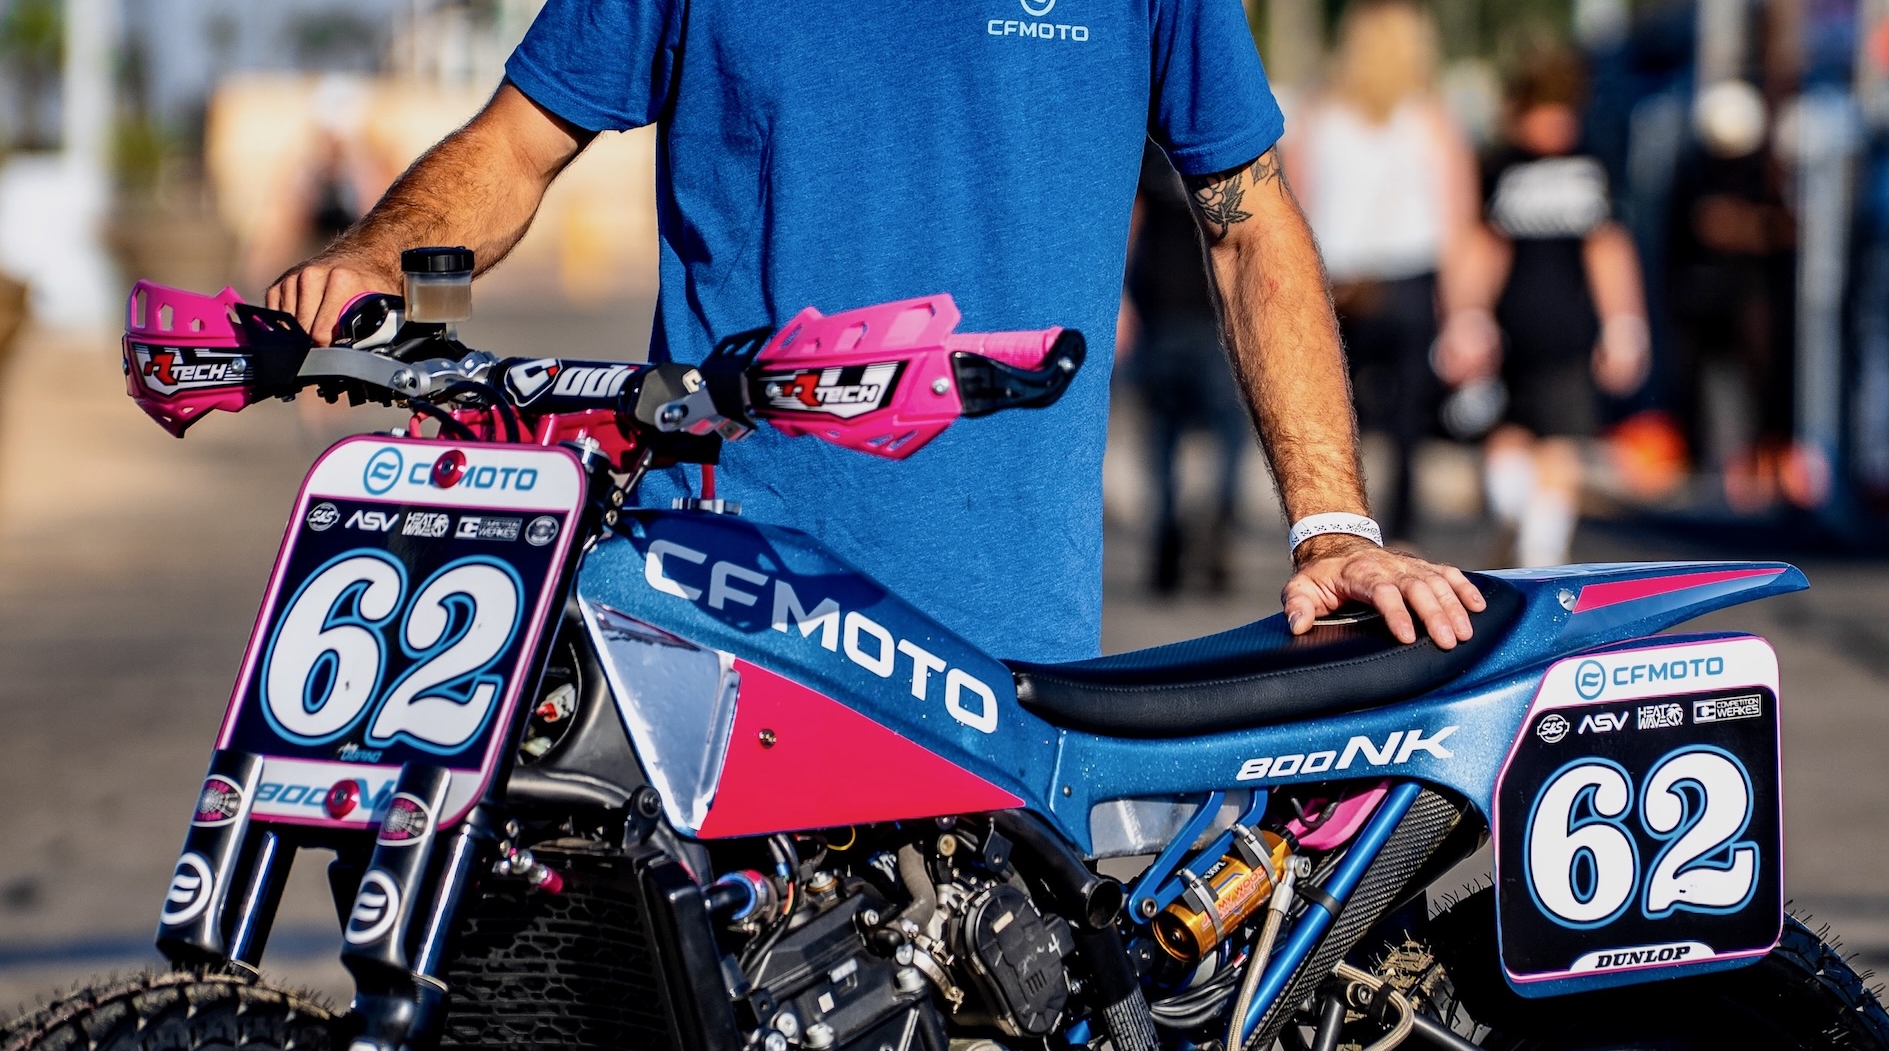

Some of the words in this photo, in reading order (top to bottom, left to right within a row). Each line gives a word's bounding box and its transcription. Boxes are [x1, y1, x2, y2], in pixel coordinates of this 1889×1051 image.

[987, 19, 1089, 42] CFMOTO
[408, 462, 539, 491] CMOTO
[344, 509, 400, 532] ASV
[644, 539, 998, 734] CFMOTO
[260, 549, 525, 754] 62
[1613, 656, 1724, 686] CFMOTO
[1637, 704, 1670, 718] HEAT
[1716, 698, 1759, 709] COMPETITION
[1716, 704, 1759, 718] WERKES
[1540, 720, 1565, 735] S&S
[1577, 711, 1630, 735] ASV
[1637, 715, 1672, 730] WAVE
[1524, 745, 1760, 929] 62
[1595, 946, 1691, 969] DUNLOP
